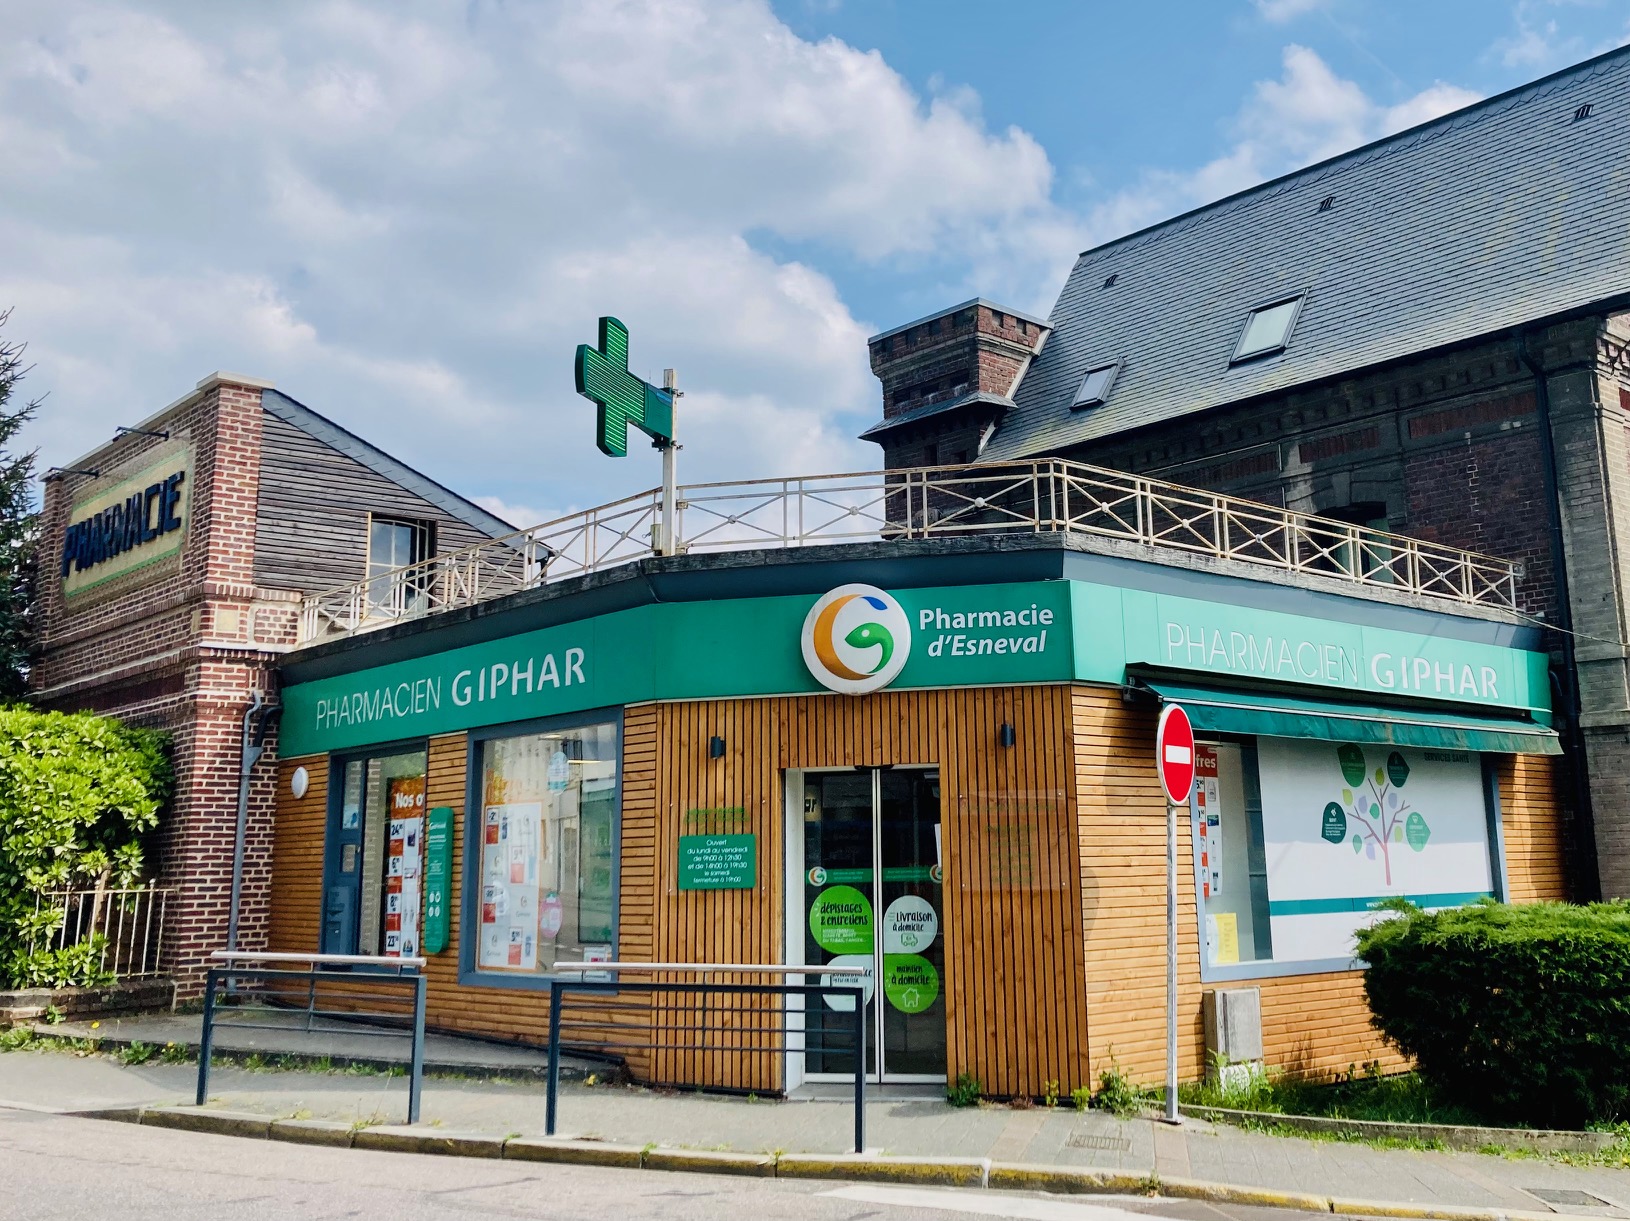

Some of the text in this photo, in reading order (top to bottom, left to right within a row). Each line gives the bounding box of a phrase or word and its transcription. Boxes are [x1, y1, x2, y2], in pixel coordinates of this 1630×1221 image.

[61, 471, 185, 578] PHARMACIE
[919, 603, 1054, 630] Pharmacie
[927, 630, 1047, 657] d'Esneval
[1166, 622, 1499, 699] PHARMACIEN GIPHAR
[315, 647, 586, 731] PHARMACIEN GIPHAR
[395, 793, 414, 809] Nos
[696, 847, 711, 855] lundi
[820, 902, 863, 915] dépistages
[827, 914, 868, 926] entretiens
[896, 911, 932, 923] Livraison
[898, 922, 924, 931] domicile
[897, 974, 930, 986] domicile
